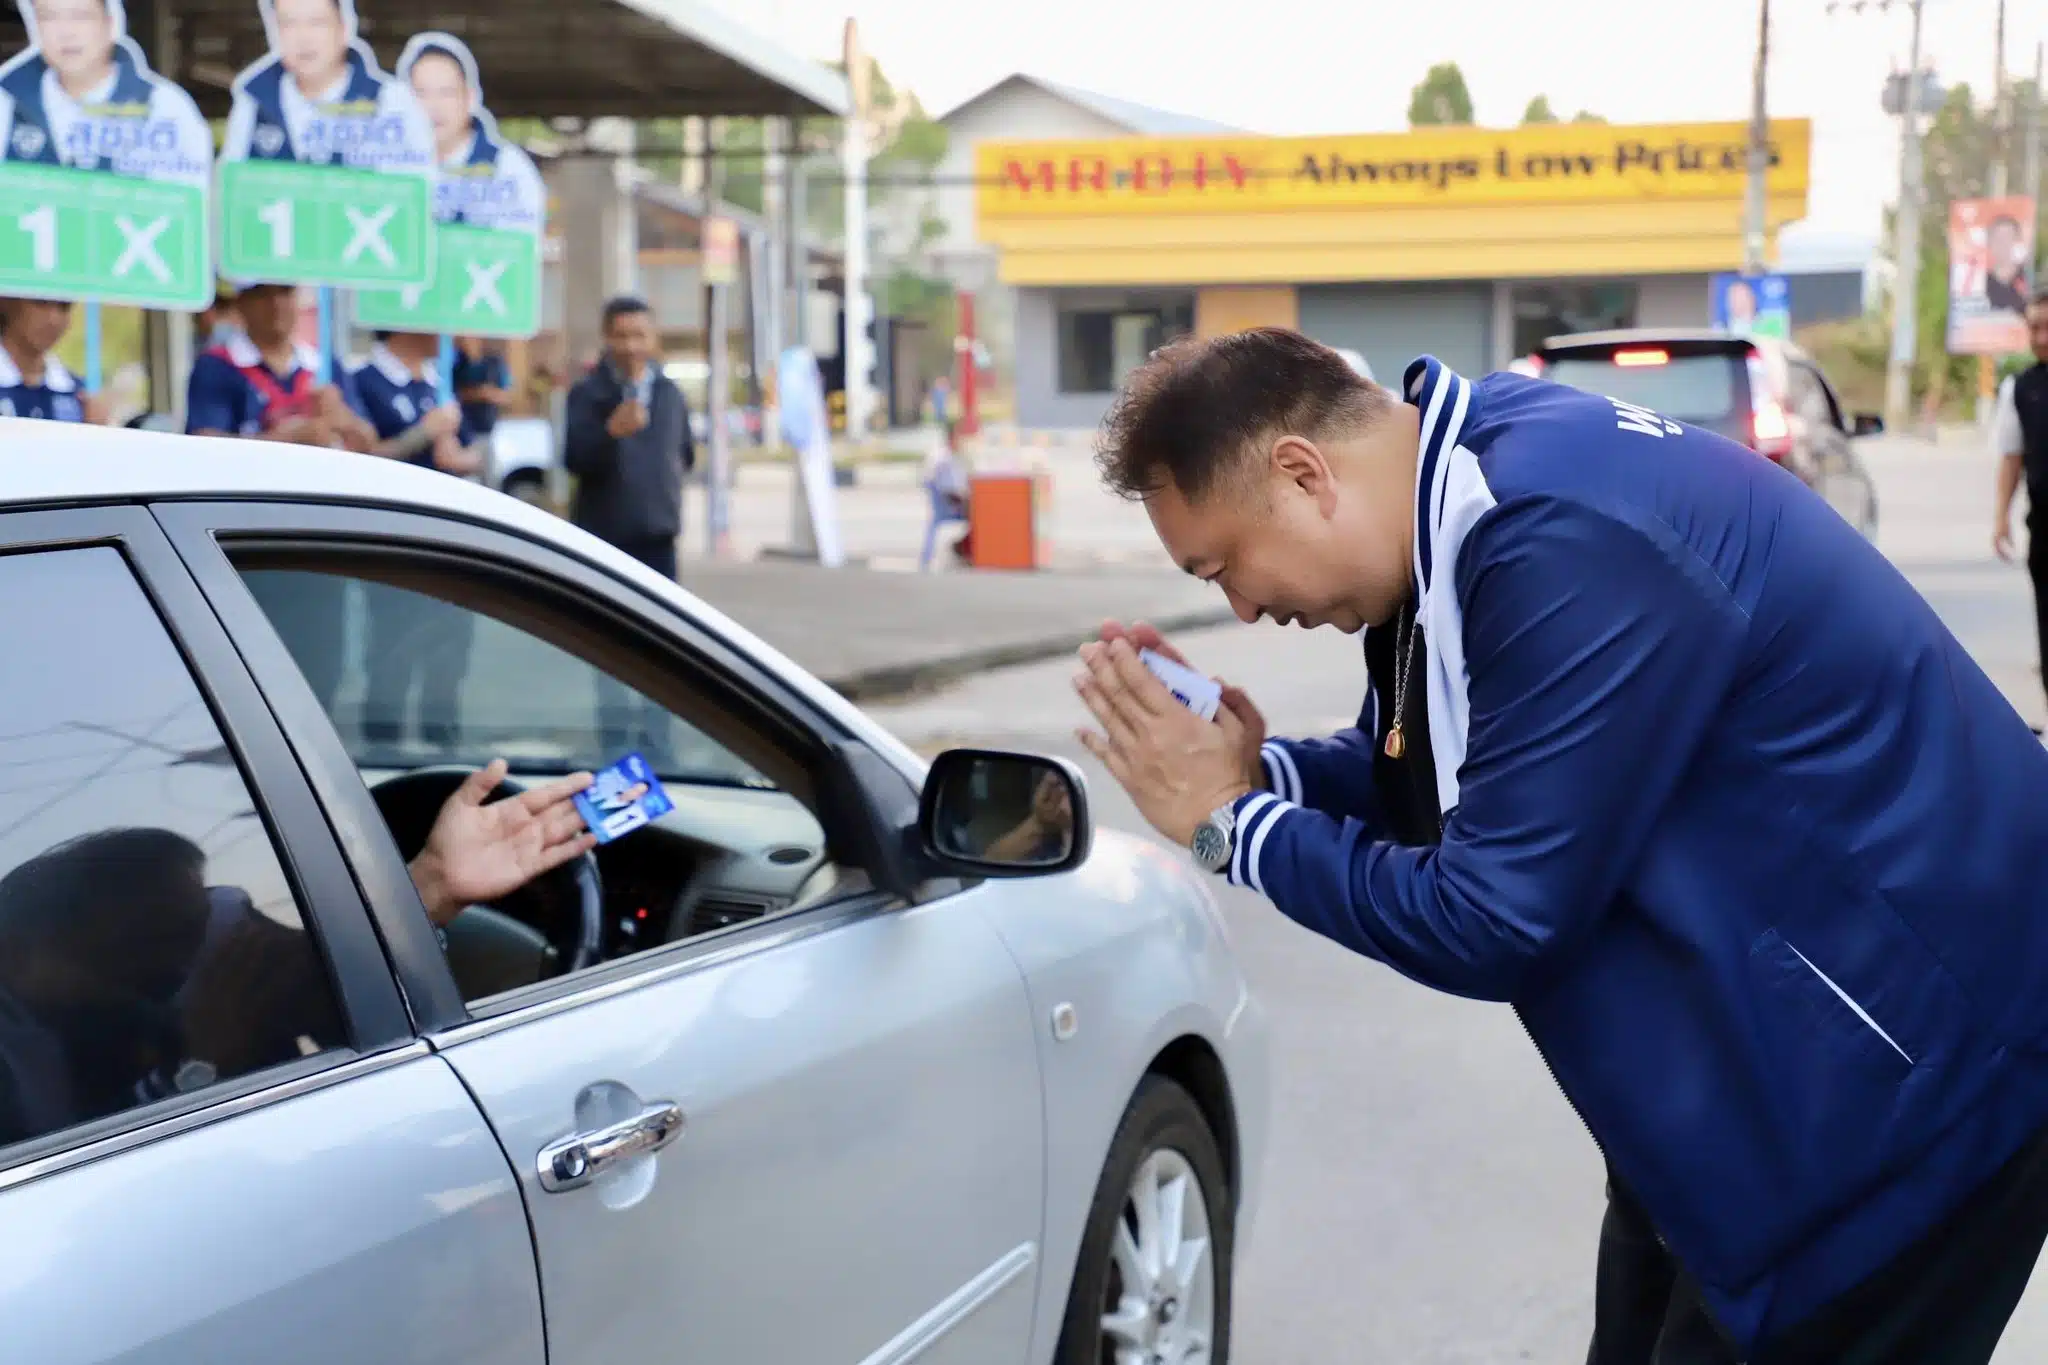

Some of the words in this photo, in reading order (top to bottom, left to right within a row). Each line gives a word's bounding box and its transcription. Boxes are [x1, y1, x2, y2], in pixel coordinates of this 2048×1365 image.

[1290, 152, 1479, 192] Always
[1491, 143, 1602, 179] Low
[18, 203, 58, 273] 1
[258, 198, 294, 258] 1
